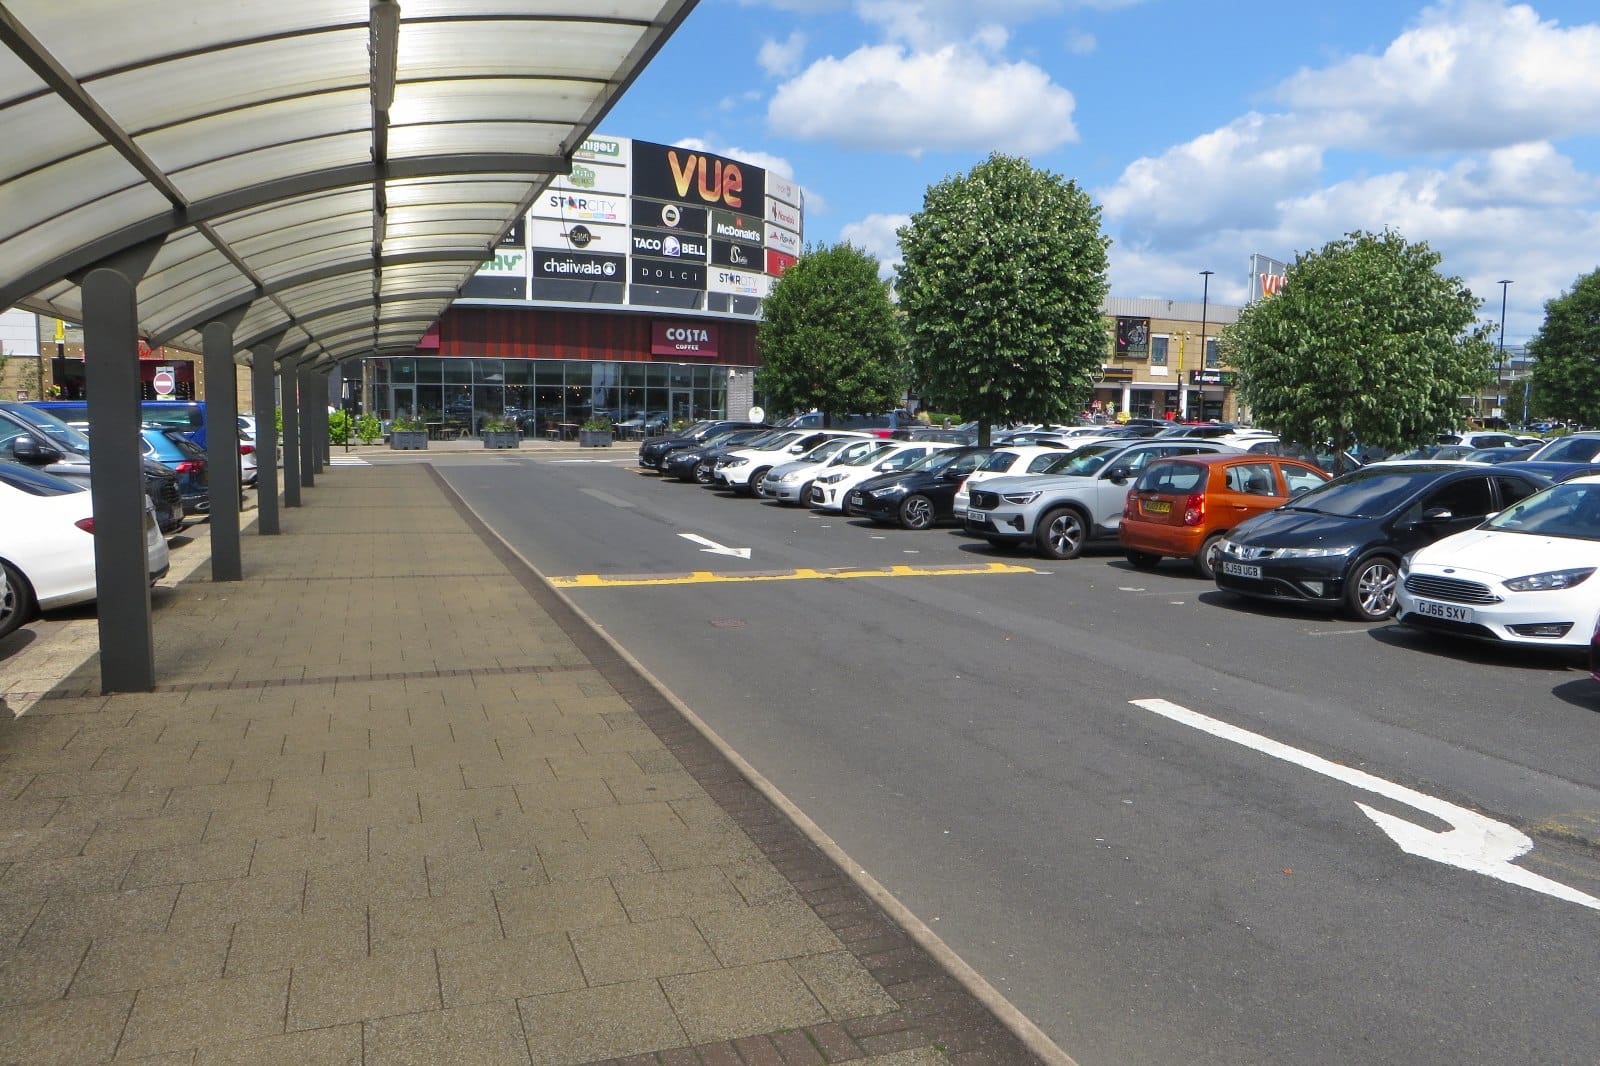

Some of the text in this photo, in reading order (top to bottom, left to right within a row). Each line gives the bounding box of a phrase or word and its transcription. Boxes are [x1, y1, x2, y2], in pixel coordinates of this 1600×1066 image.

[716, 223, 761, 242] McDonald's
[633, 237, 706, 256] TACO BELL
[543, 257, 602, 275] chaiiwala
[665, 327, 709, 343] COSTA
[675, 343, 700, 351] COFFEE
[1419, 602, 1466, 620] GJ66 SXV
